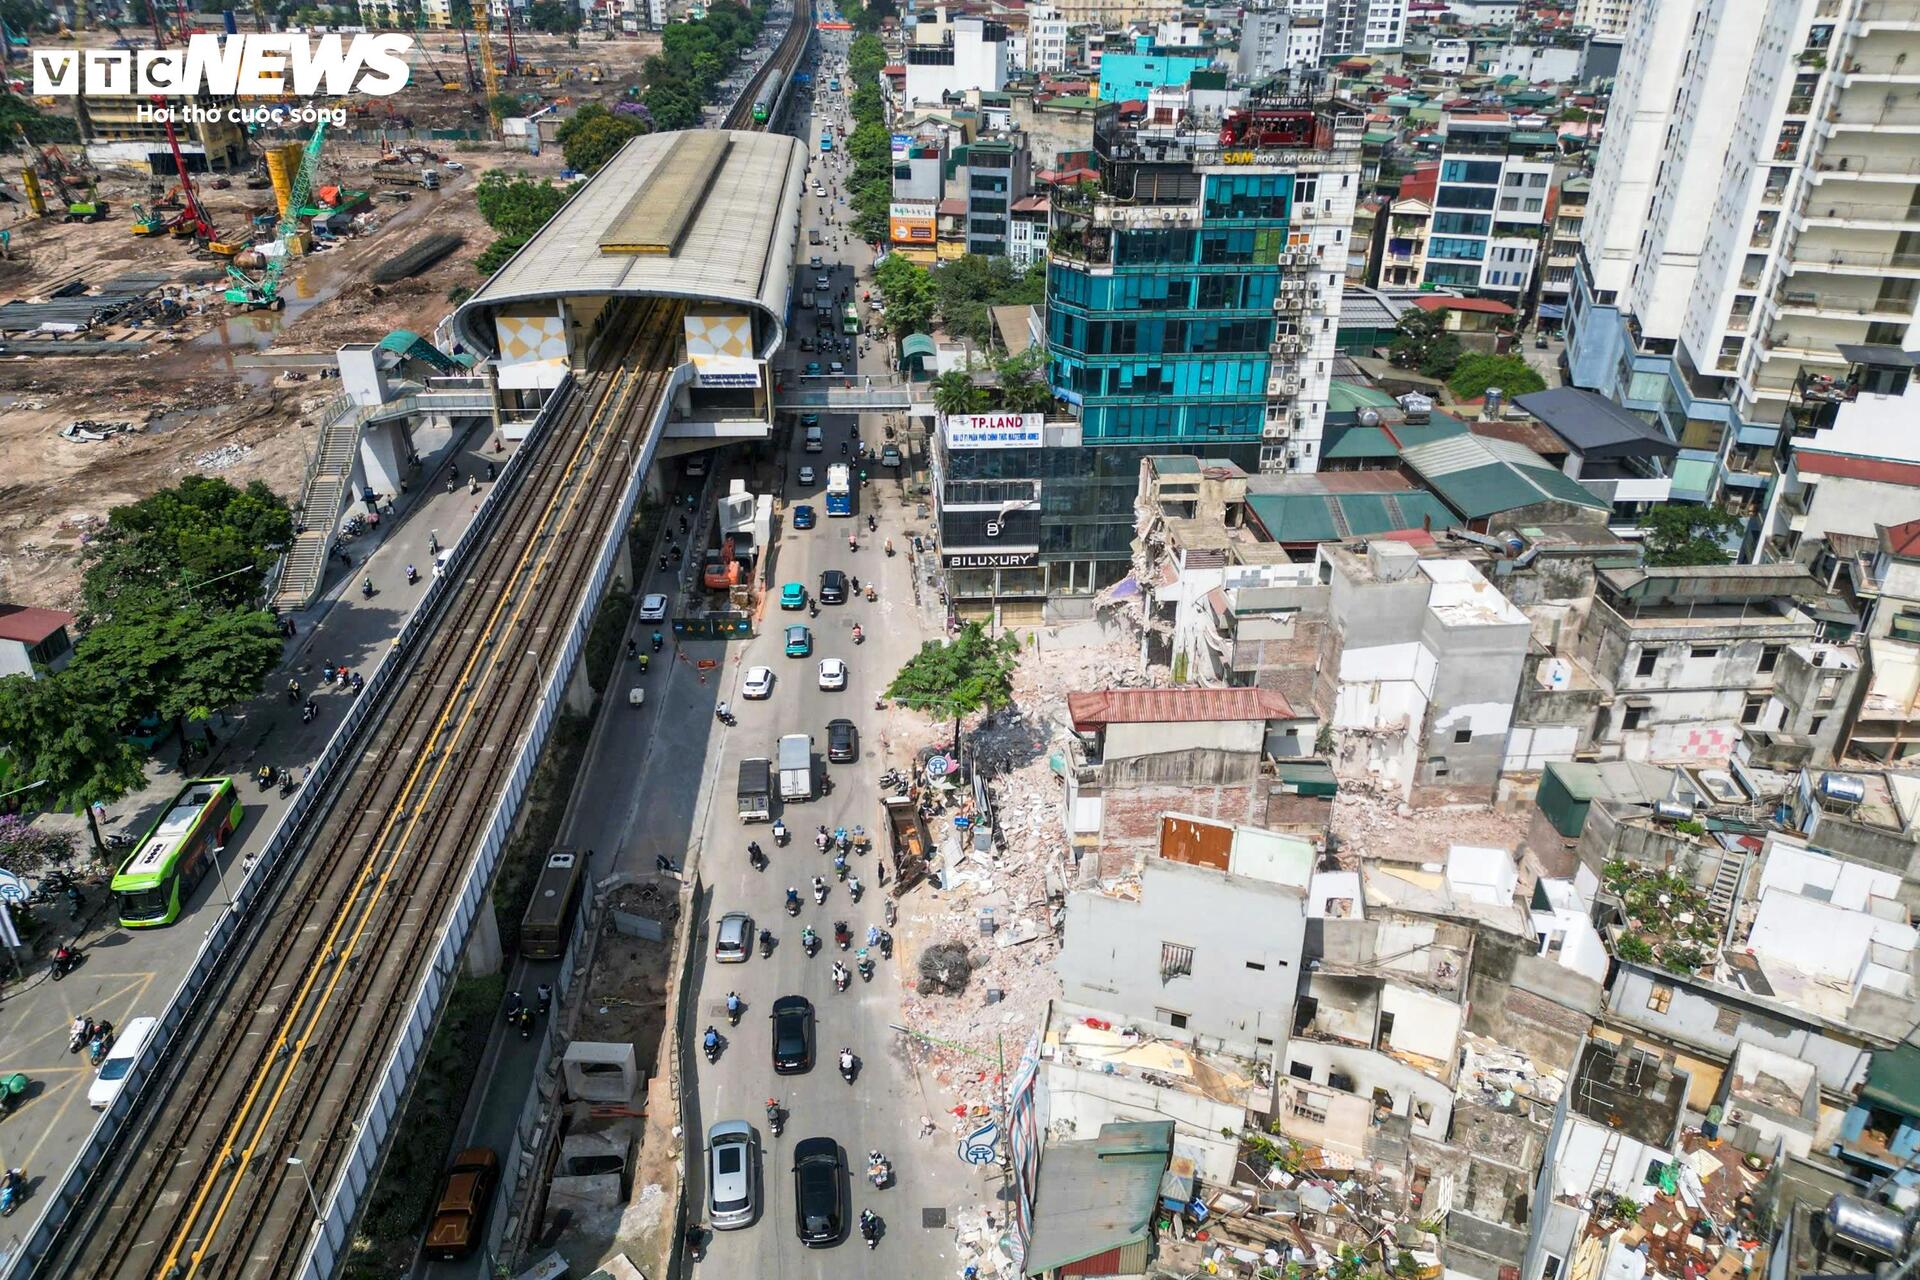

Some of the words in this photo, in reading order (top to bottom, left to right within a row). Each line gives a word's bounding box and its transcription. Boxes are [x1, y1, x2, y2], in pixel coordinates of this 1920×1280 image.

[1223, 151, 1253, 165] SAM
[971, 416, 1023, 429] TP.LAND
[951, 556, 1029, 567] BILUXURY
